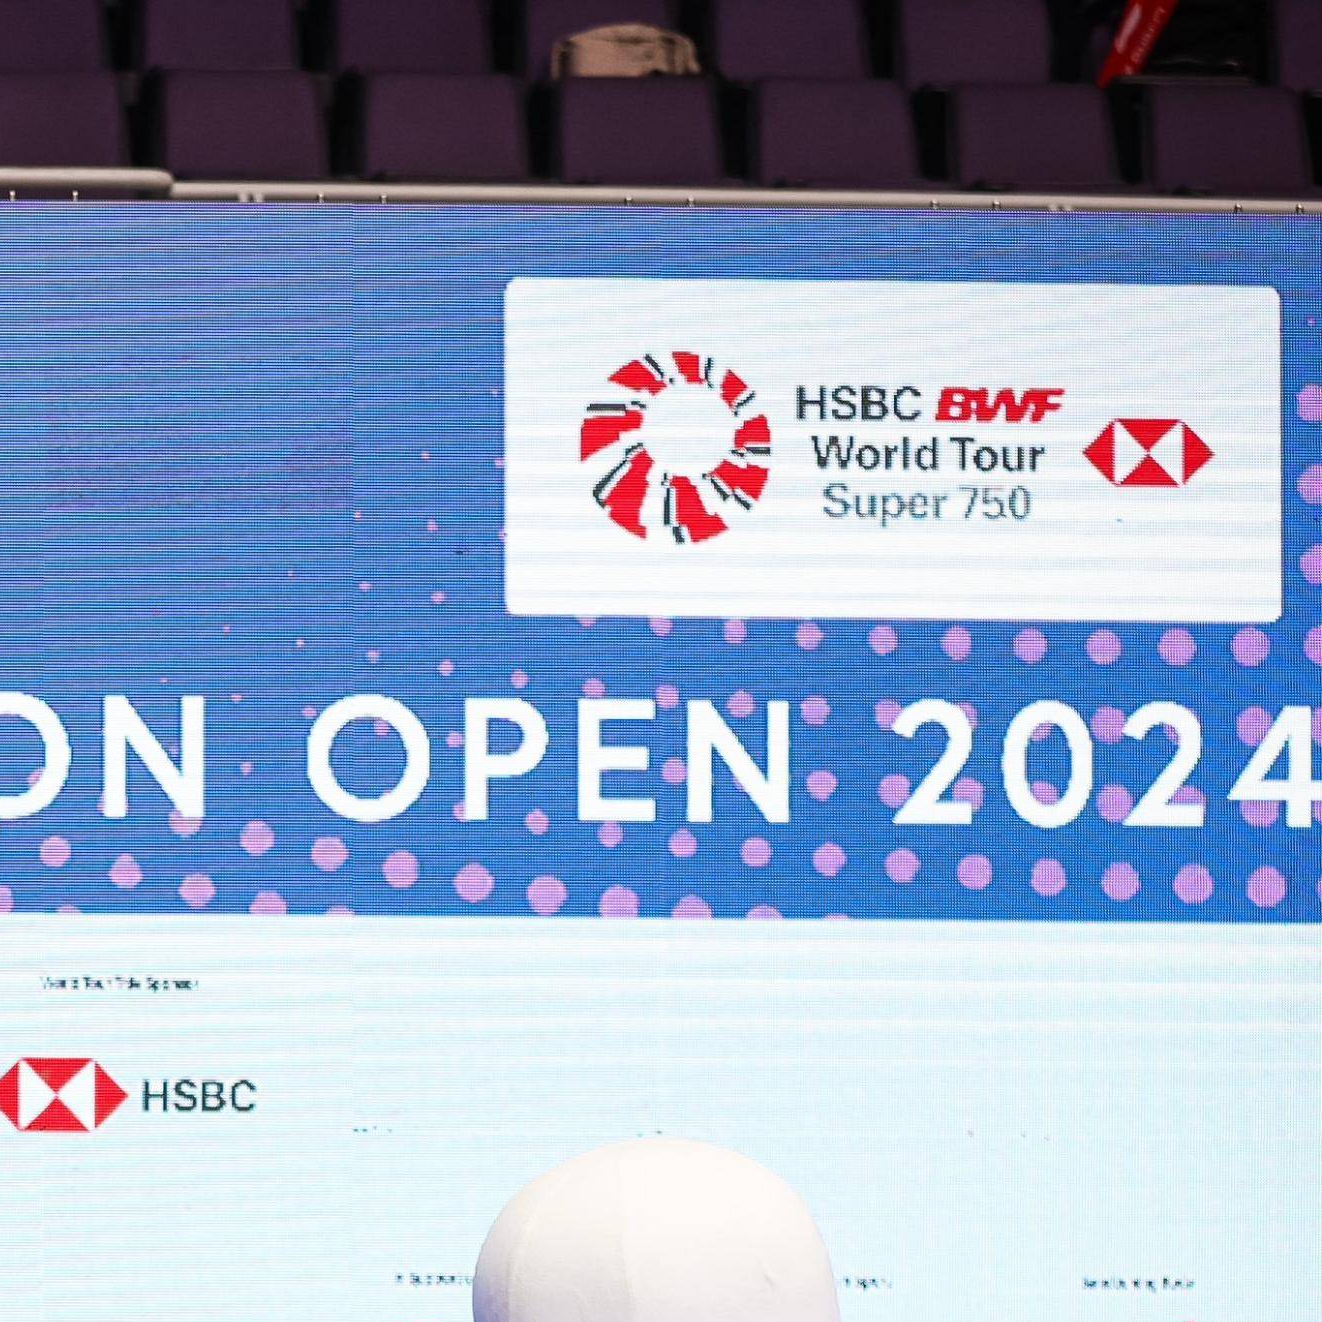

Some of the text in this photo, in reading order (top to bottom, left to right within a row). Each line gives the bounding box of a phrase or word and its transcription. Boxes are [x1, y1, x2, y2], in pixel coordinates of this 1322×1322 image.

[796, 385, 1065, 422] HSBC BWF
[811, 436, 1045, 471] World Tour
[823, 483, 1031, 527] Super 750
[306, 694, 790, 823] OPEN
[890, 699, 1322, 828] 2024
[141, 1079, 257, 1112] HSBC
